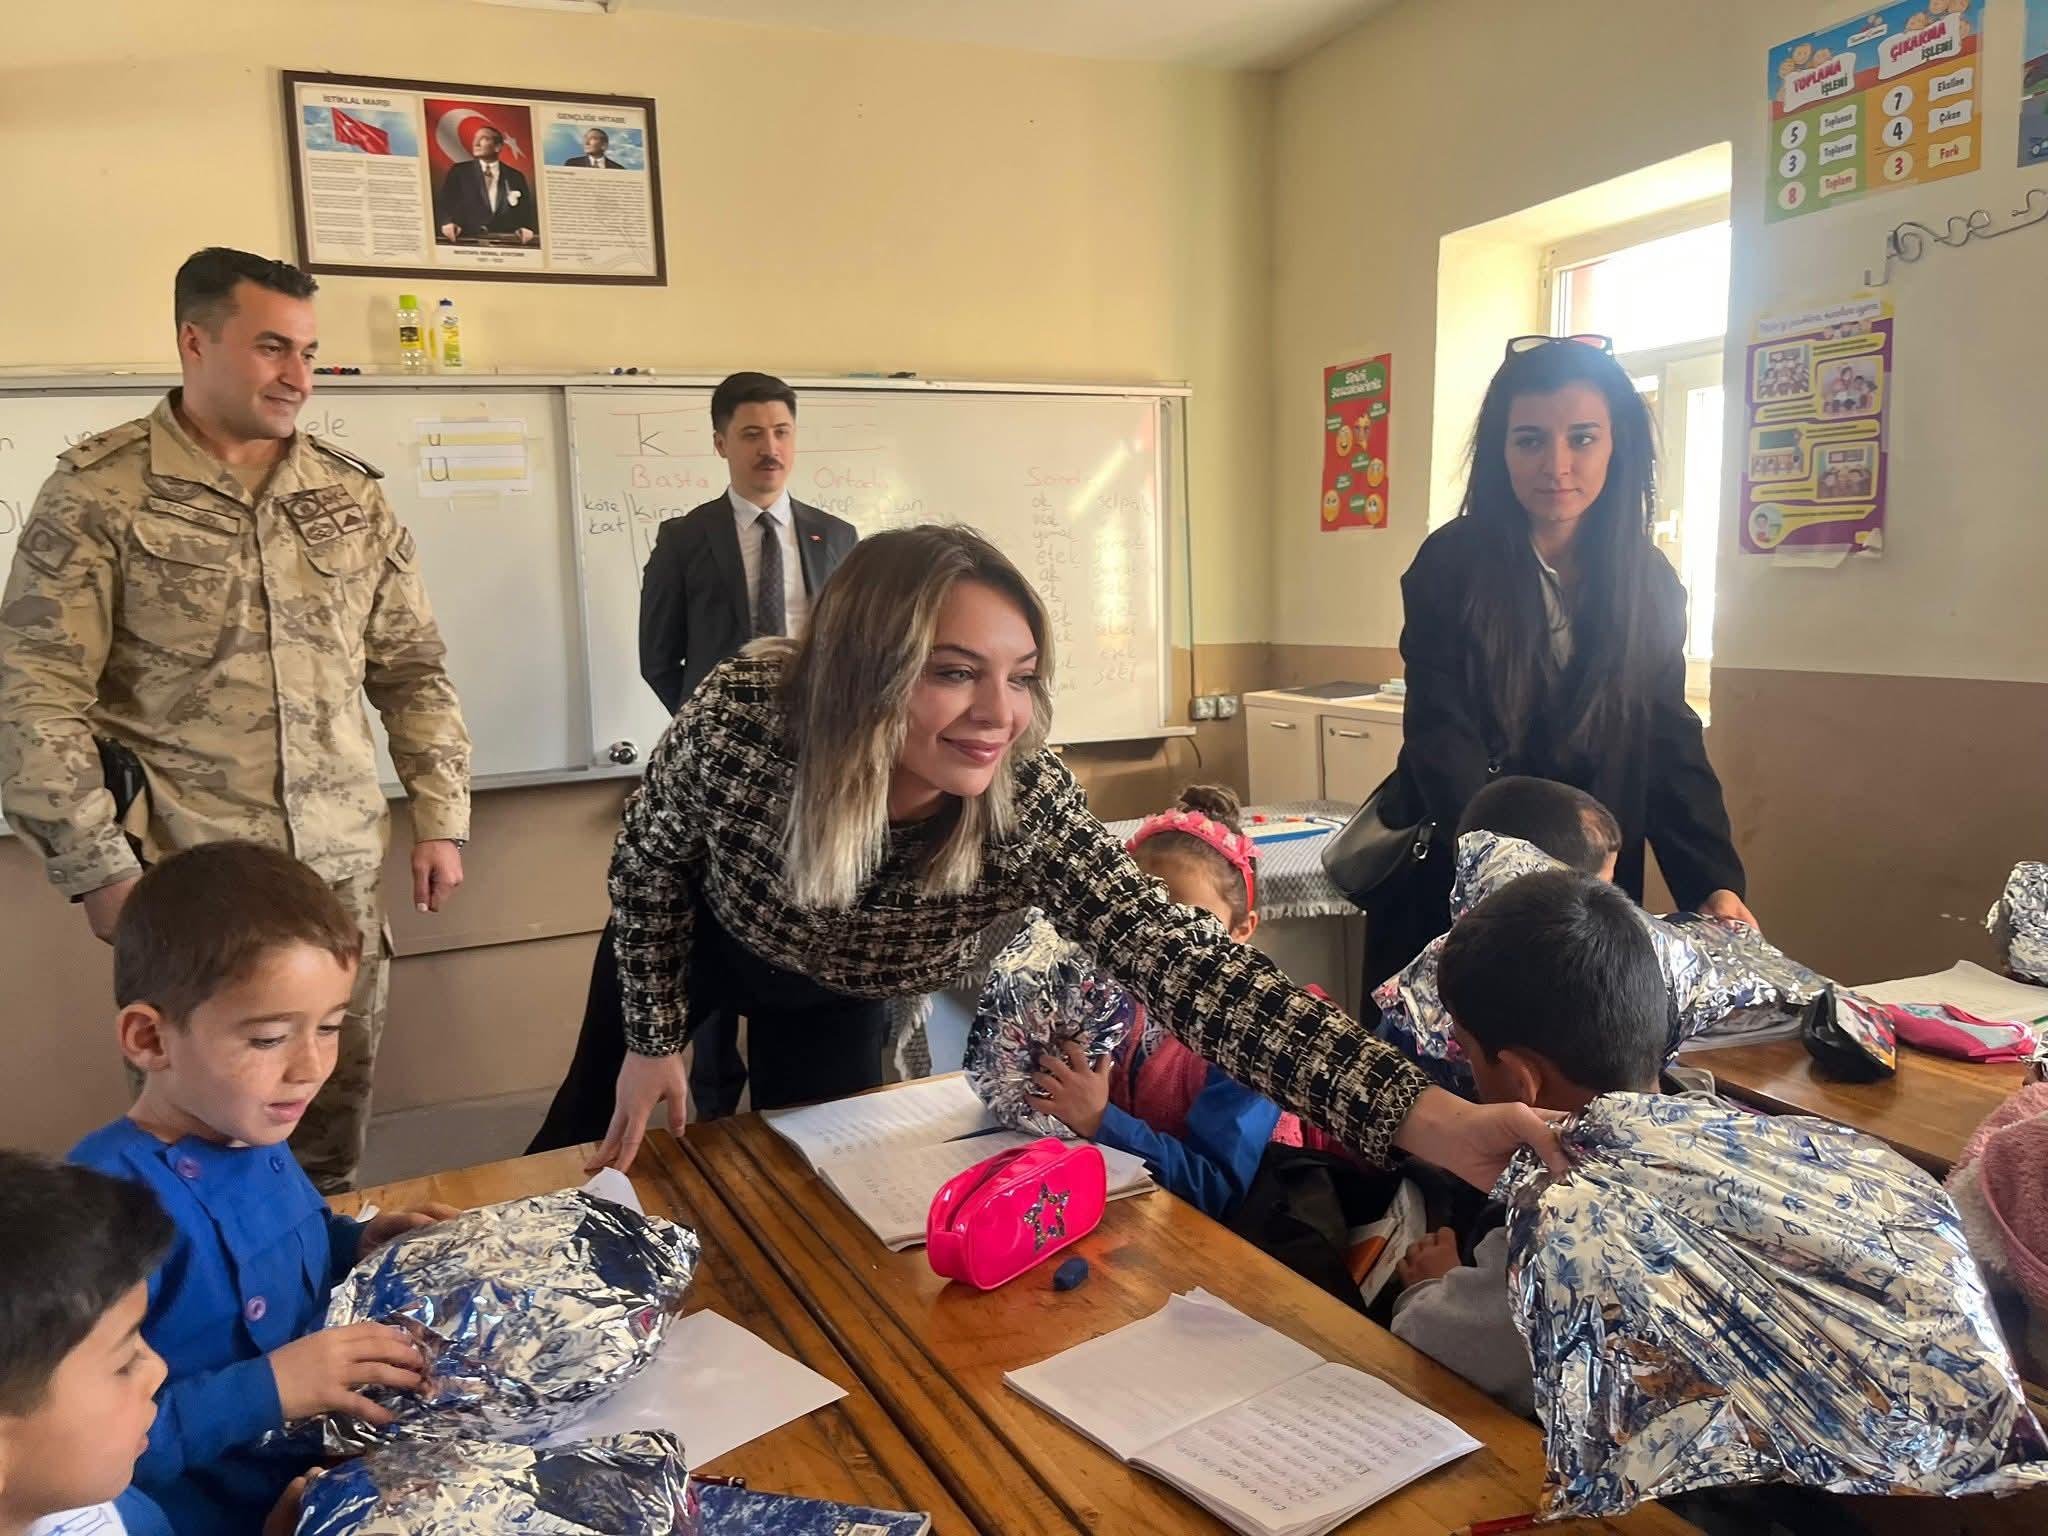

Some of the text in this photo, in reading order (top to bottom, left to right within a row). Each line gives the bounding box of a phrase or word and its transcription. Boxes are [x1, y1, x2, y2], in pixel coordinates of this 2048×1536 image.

[1894, 92, 1903, 111] 7
[1790, 126, 1799, 144] 5
[1893, 122, 1904, 141] 4
[1789, 155, 1798, 173] 3
[1894, 157, 1904, 176] 3
[1787, 187, 1797, 205] 8
